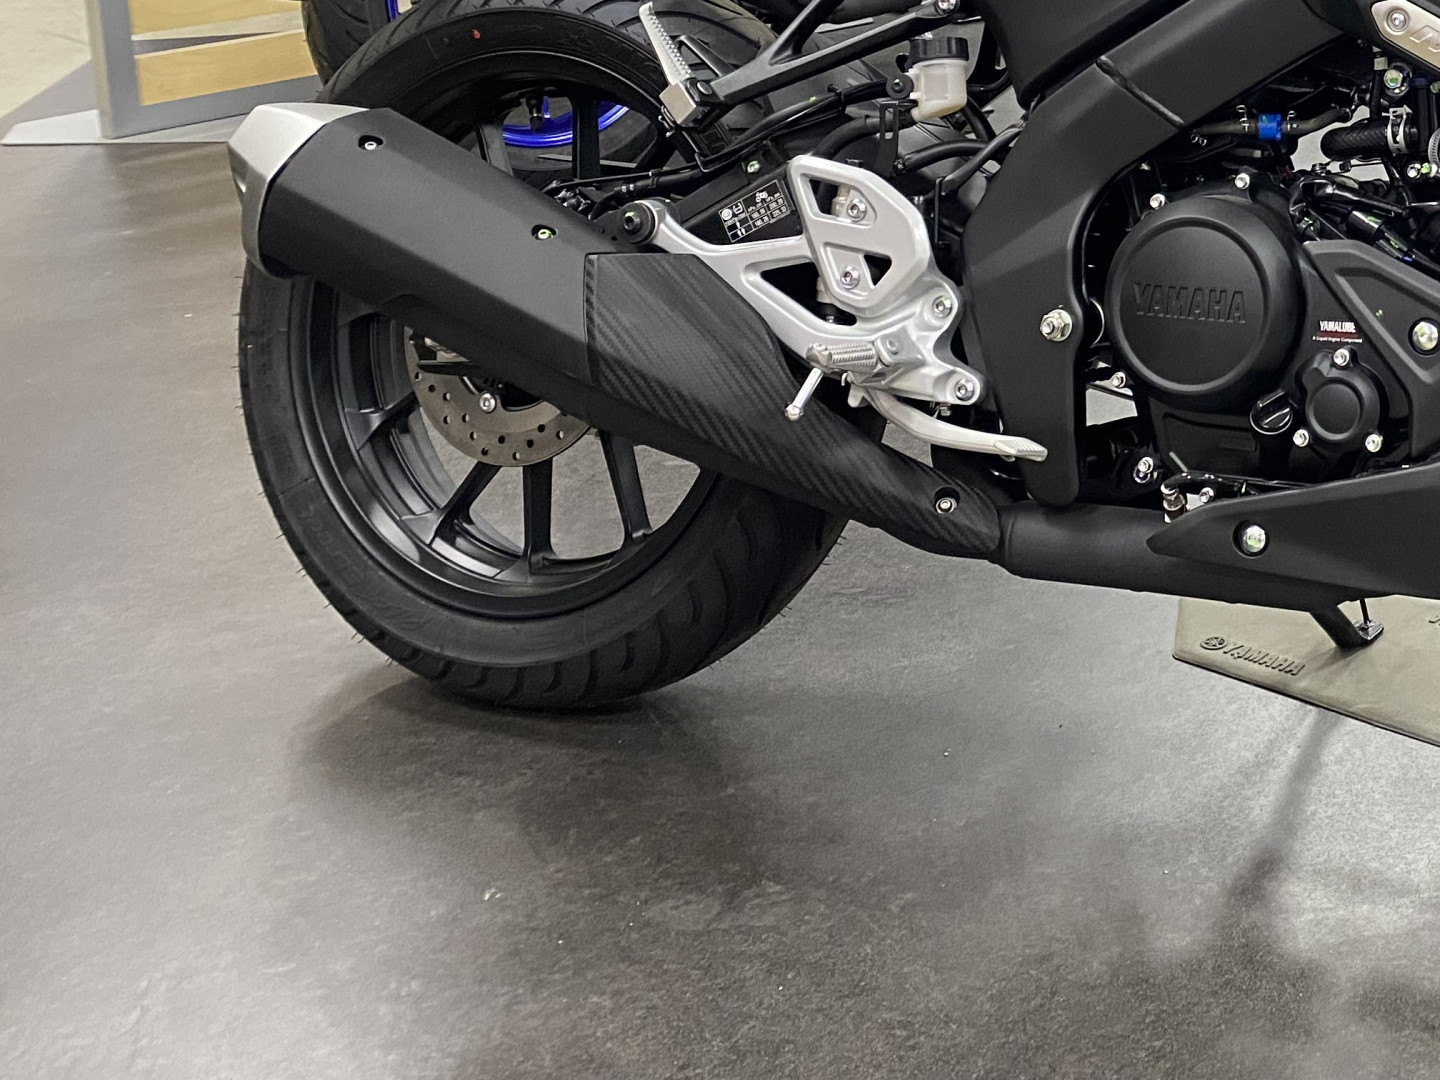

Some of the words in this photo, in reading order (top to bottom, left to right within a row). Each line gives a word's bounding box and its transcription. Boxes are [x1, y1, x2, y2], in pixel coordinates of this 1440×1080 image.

[1133, 282, 1246, 324] YAMAHA
[1319, 320, 1356, 333] YAMALUBE
[1223, 642, 1306, 676] YAMAHA
